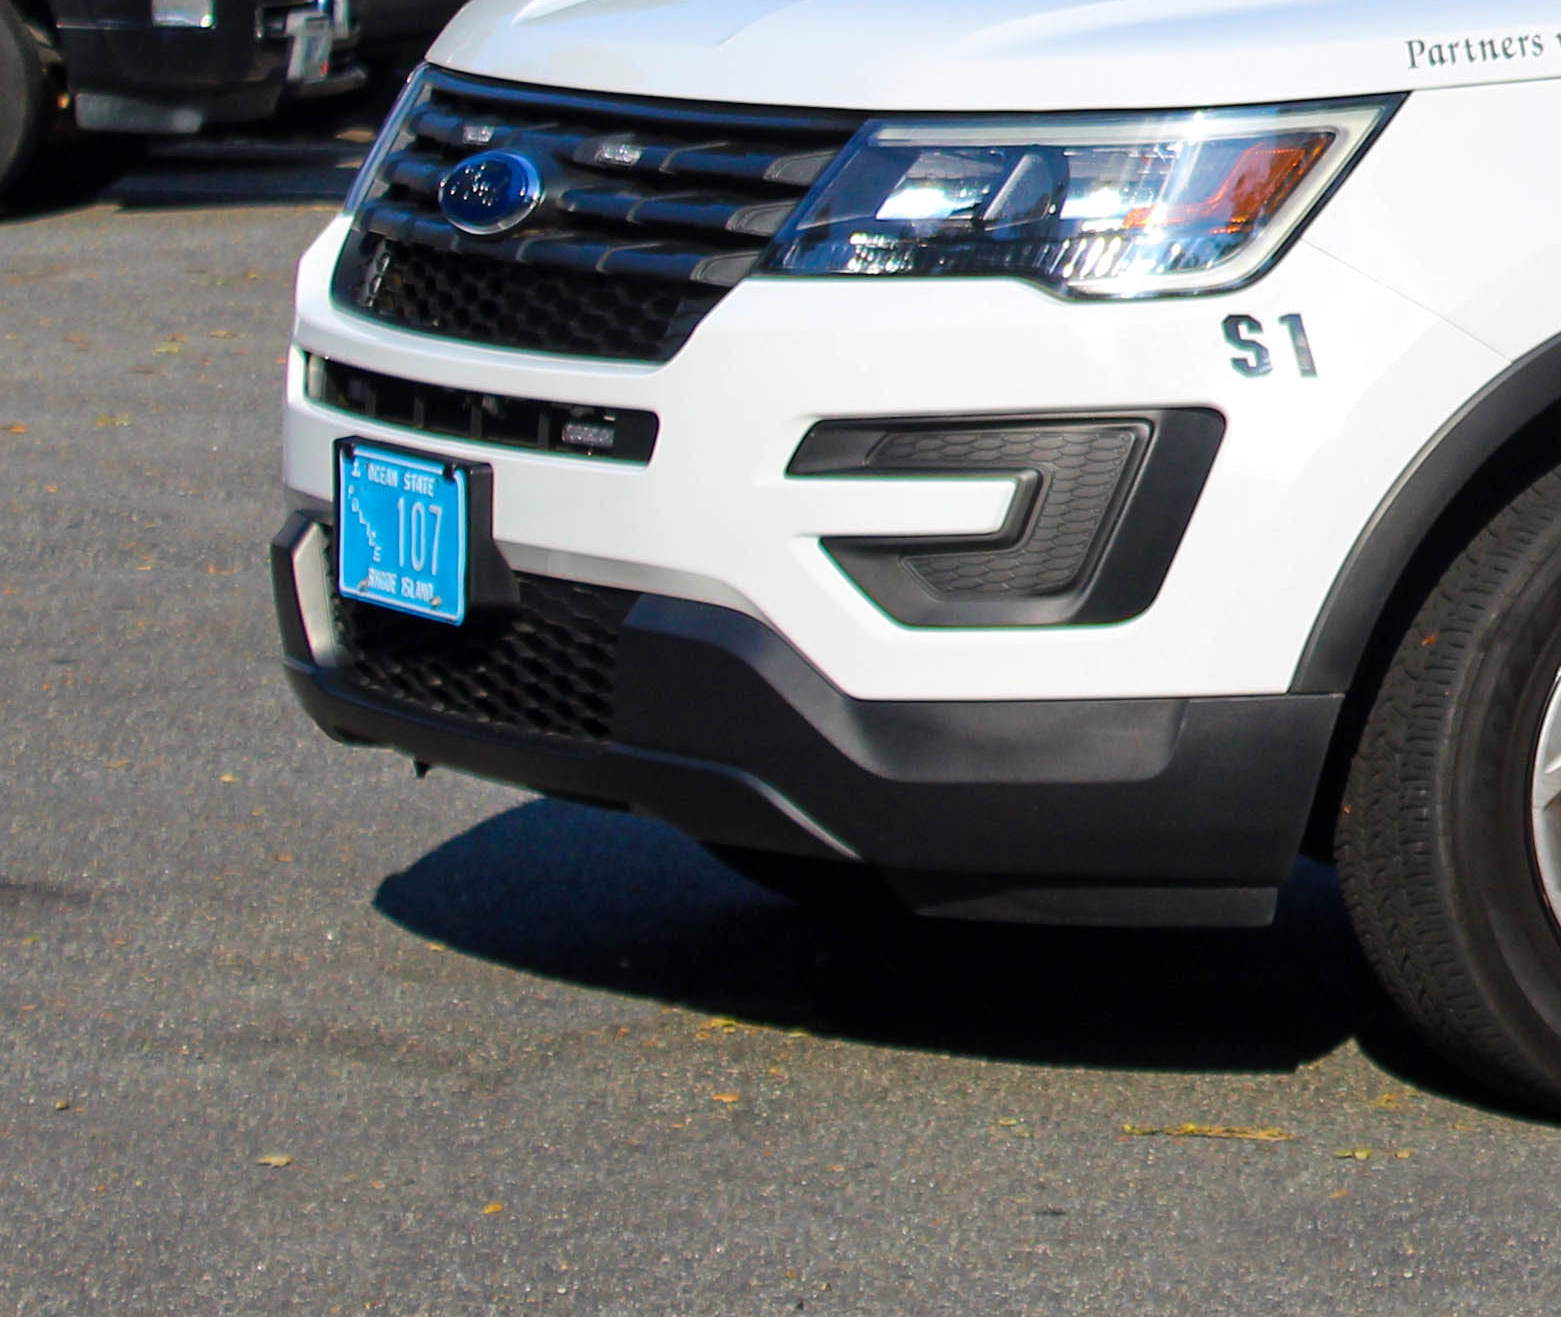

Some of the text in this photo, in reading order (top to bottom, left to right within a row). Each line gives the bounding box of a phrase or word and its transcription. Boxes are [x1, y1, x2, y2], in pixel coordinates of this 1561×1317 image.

[1405, 32, 1544, 69] Partners
[1222, 313, 1318, 378] S1
[367, 462, 435, 497] OCEAN STATE
[348, 485, 382, 562] POLICE
[398, 496, 443, 576] 107
[368, 567, 435, 601] RHODE ISLAND
